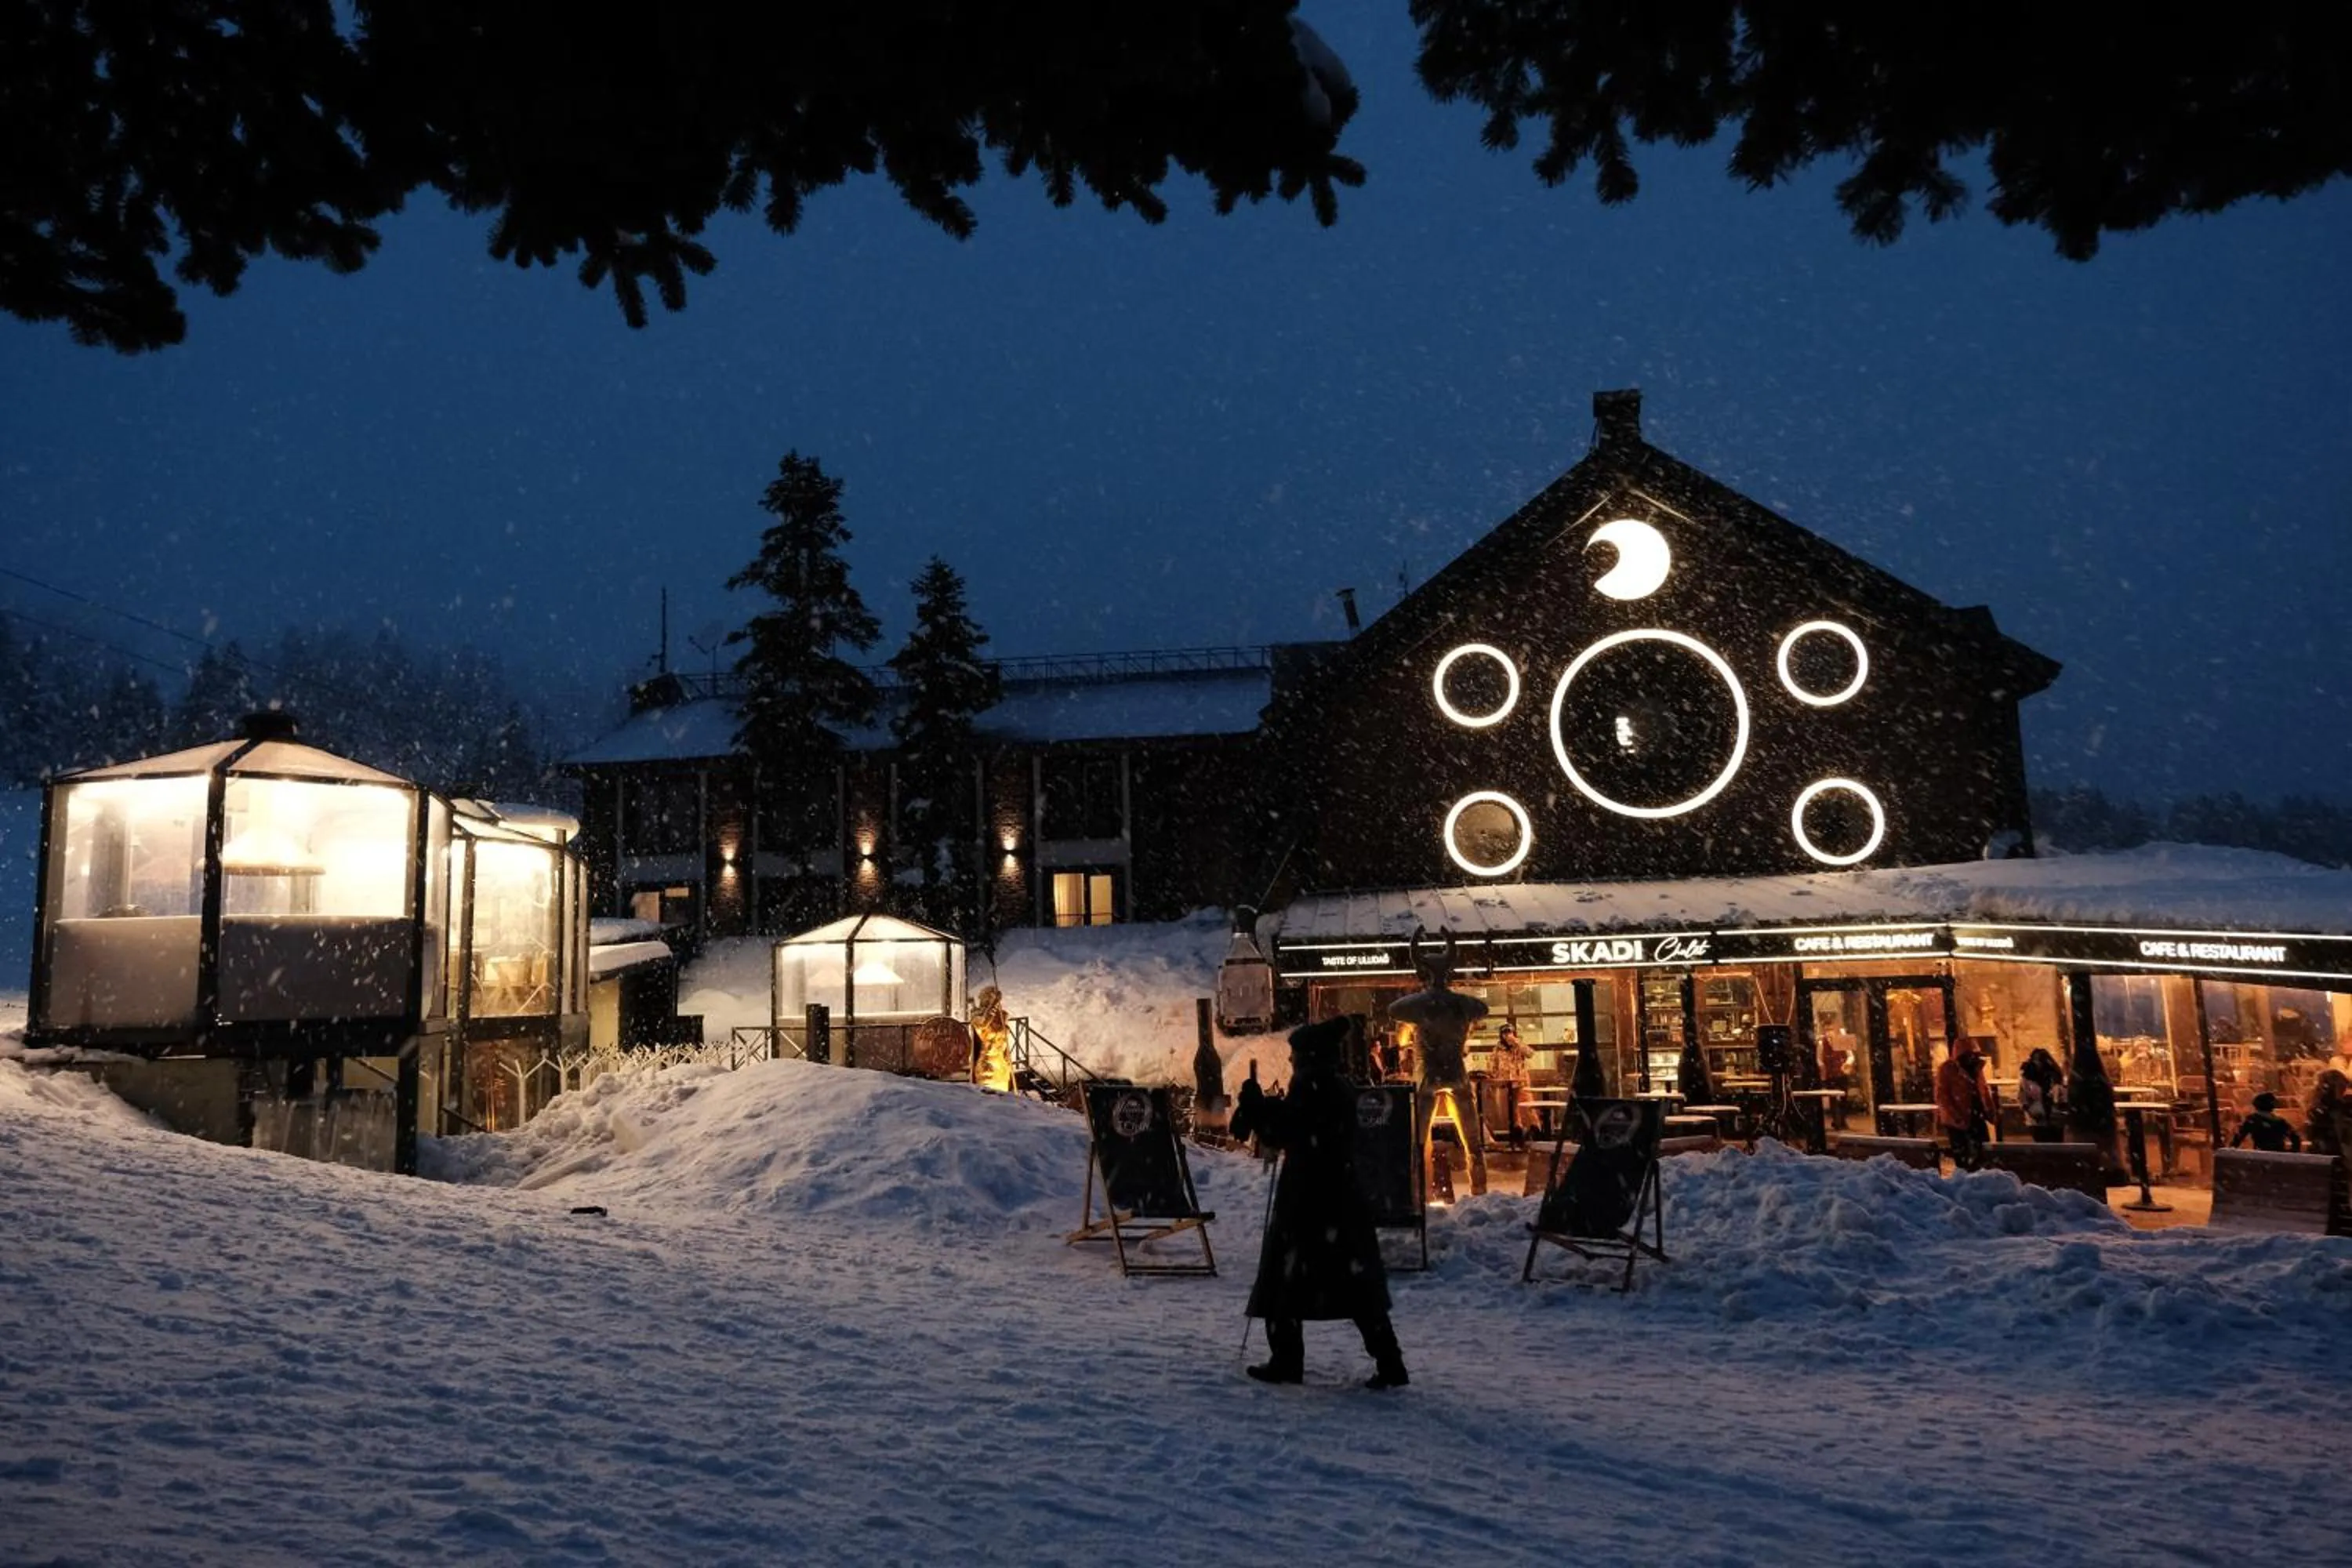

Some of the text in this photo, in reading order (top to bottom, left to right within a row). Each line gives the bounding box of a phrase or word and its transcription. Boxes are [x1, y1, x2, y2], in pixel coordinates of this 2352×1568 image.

[1552, 941, 1642, 964] SKADI
[2140, 942, 2286, 962] CAFE & RESTAURANT
